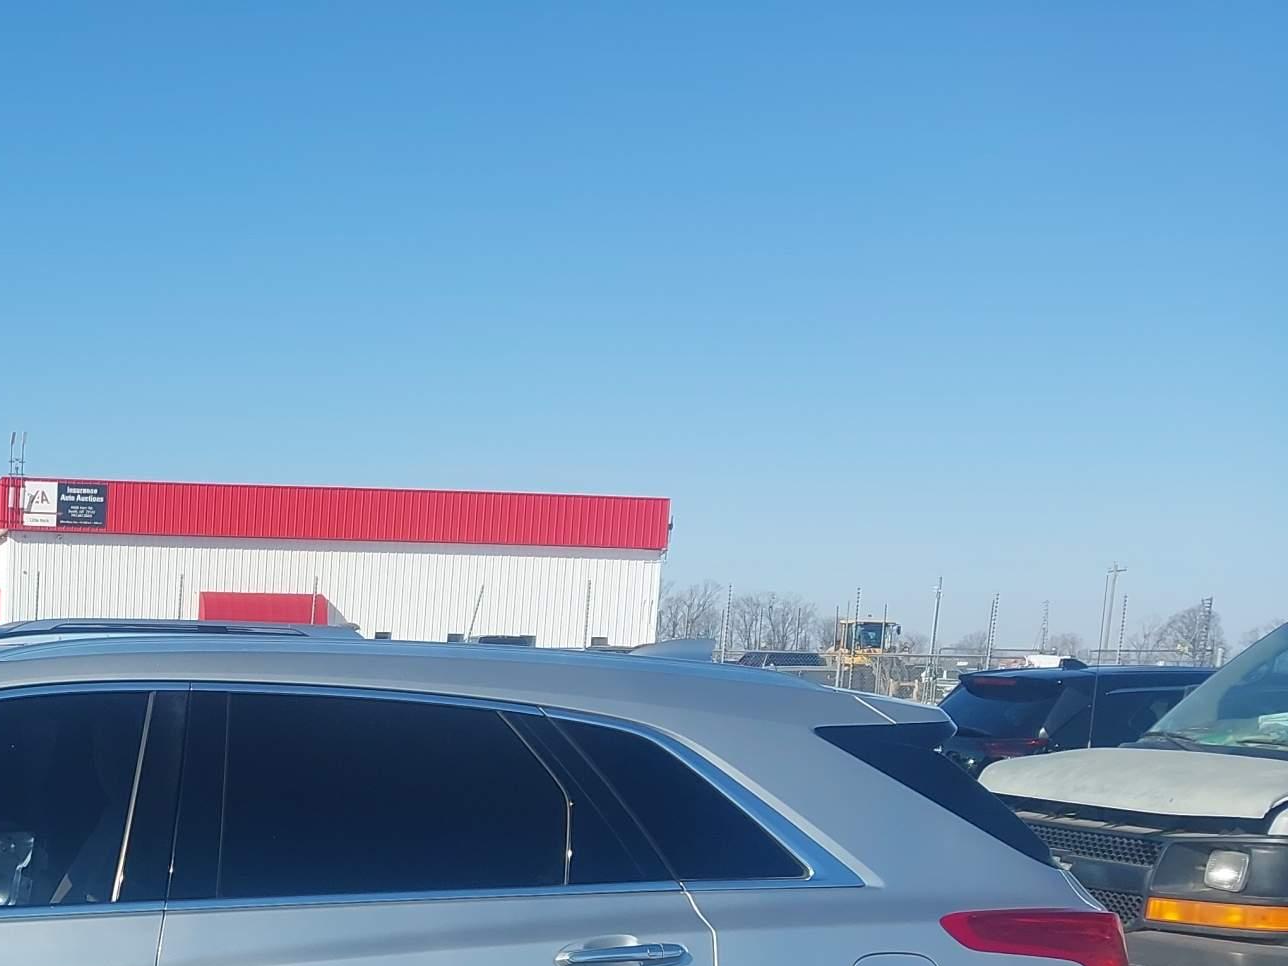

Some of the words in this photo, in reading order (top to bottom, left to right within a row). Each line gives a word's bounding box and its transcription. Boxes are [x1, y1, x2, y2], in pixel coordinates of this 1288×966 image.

[66, 485, 98, 494] Insurance
[60, 494, 75, 502] Auto
[76, 494, 104, 503] Auctions
